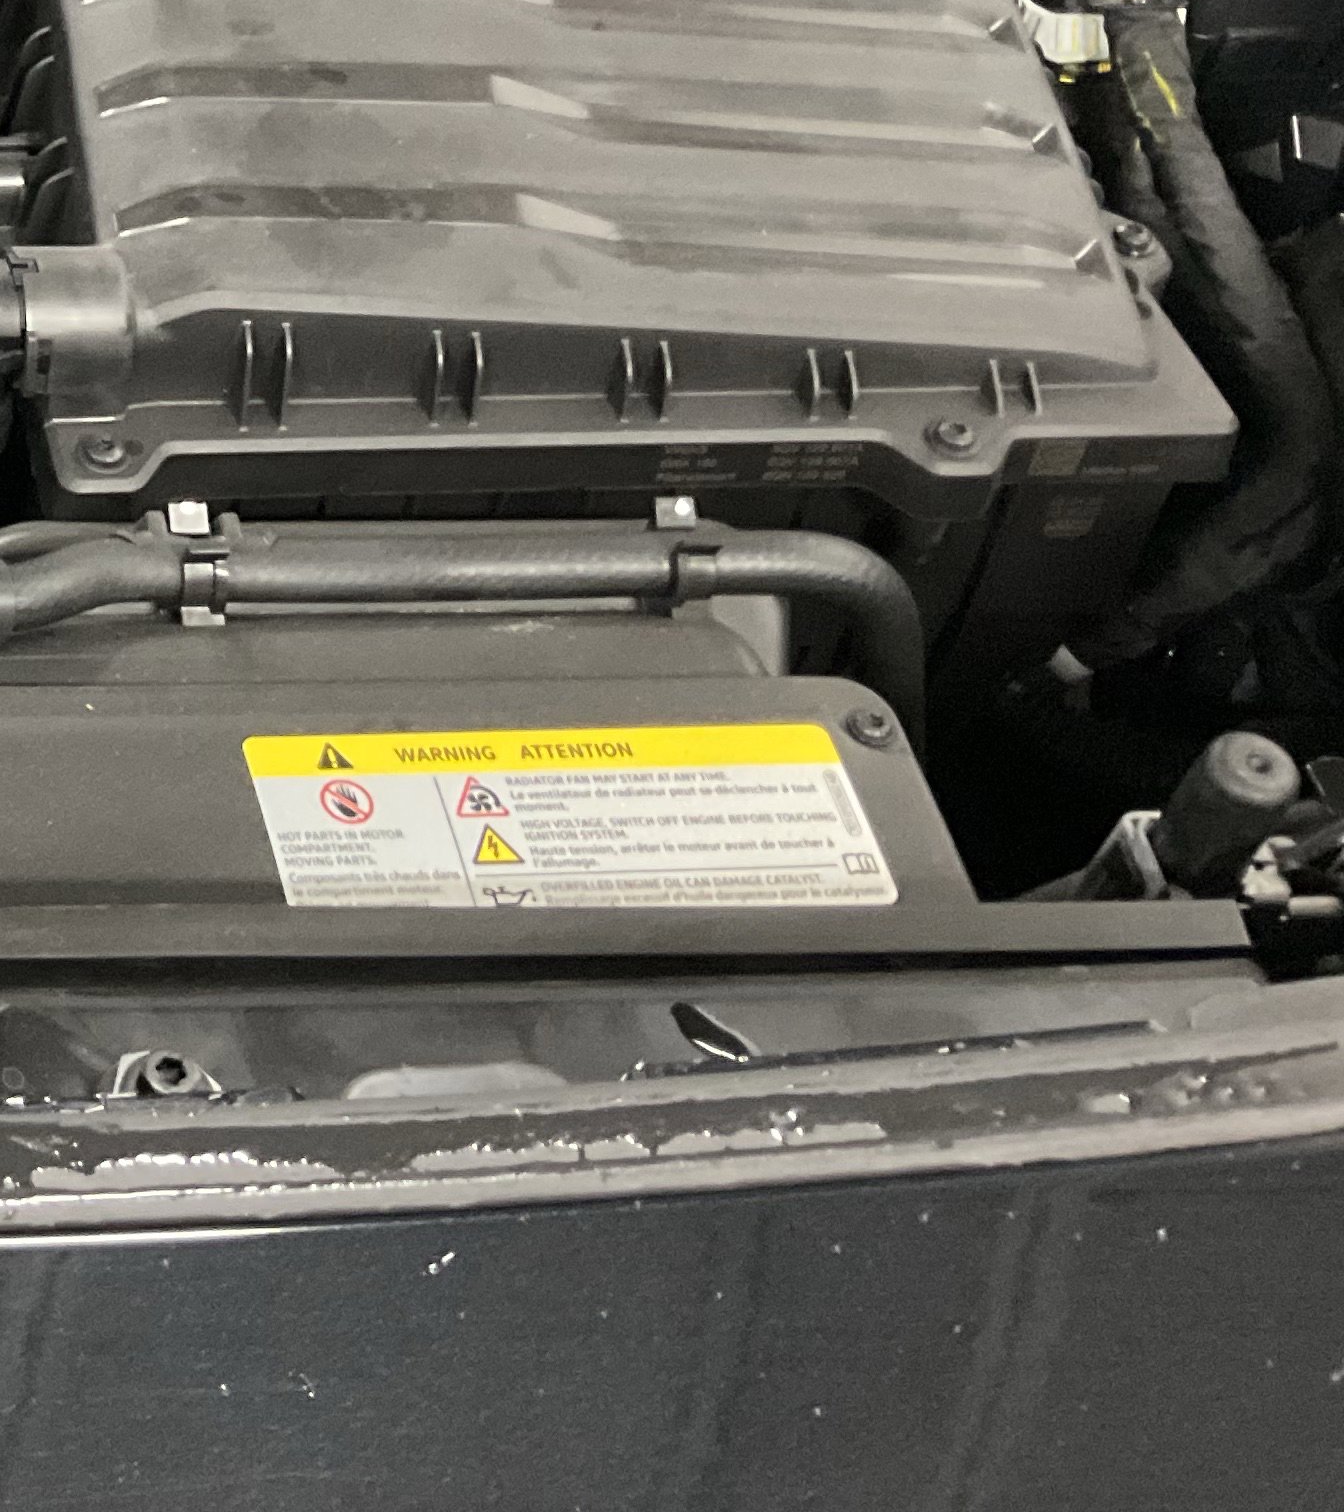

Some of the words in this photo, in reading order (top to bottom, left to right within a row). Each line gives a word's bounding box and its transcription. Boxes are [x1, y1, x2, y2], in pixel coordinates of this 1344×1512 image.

[394, 745, 497, 763] WARNING
[520, 742, 634, 760] ATTENTION
[505, 775, 565, 787] RADIATOR
[567, 775, 590, 785] FAN
[595, 789, 610, 798] de
[521, 819, 550, 830] HIGH
[609, 816, 654, 827] SWITCH
[657, 816, 679, 826] OFF
